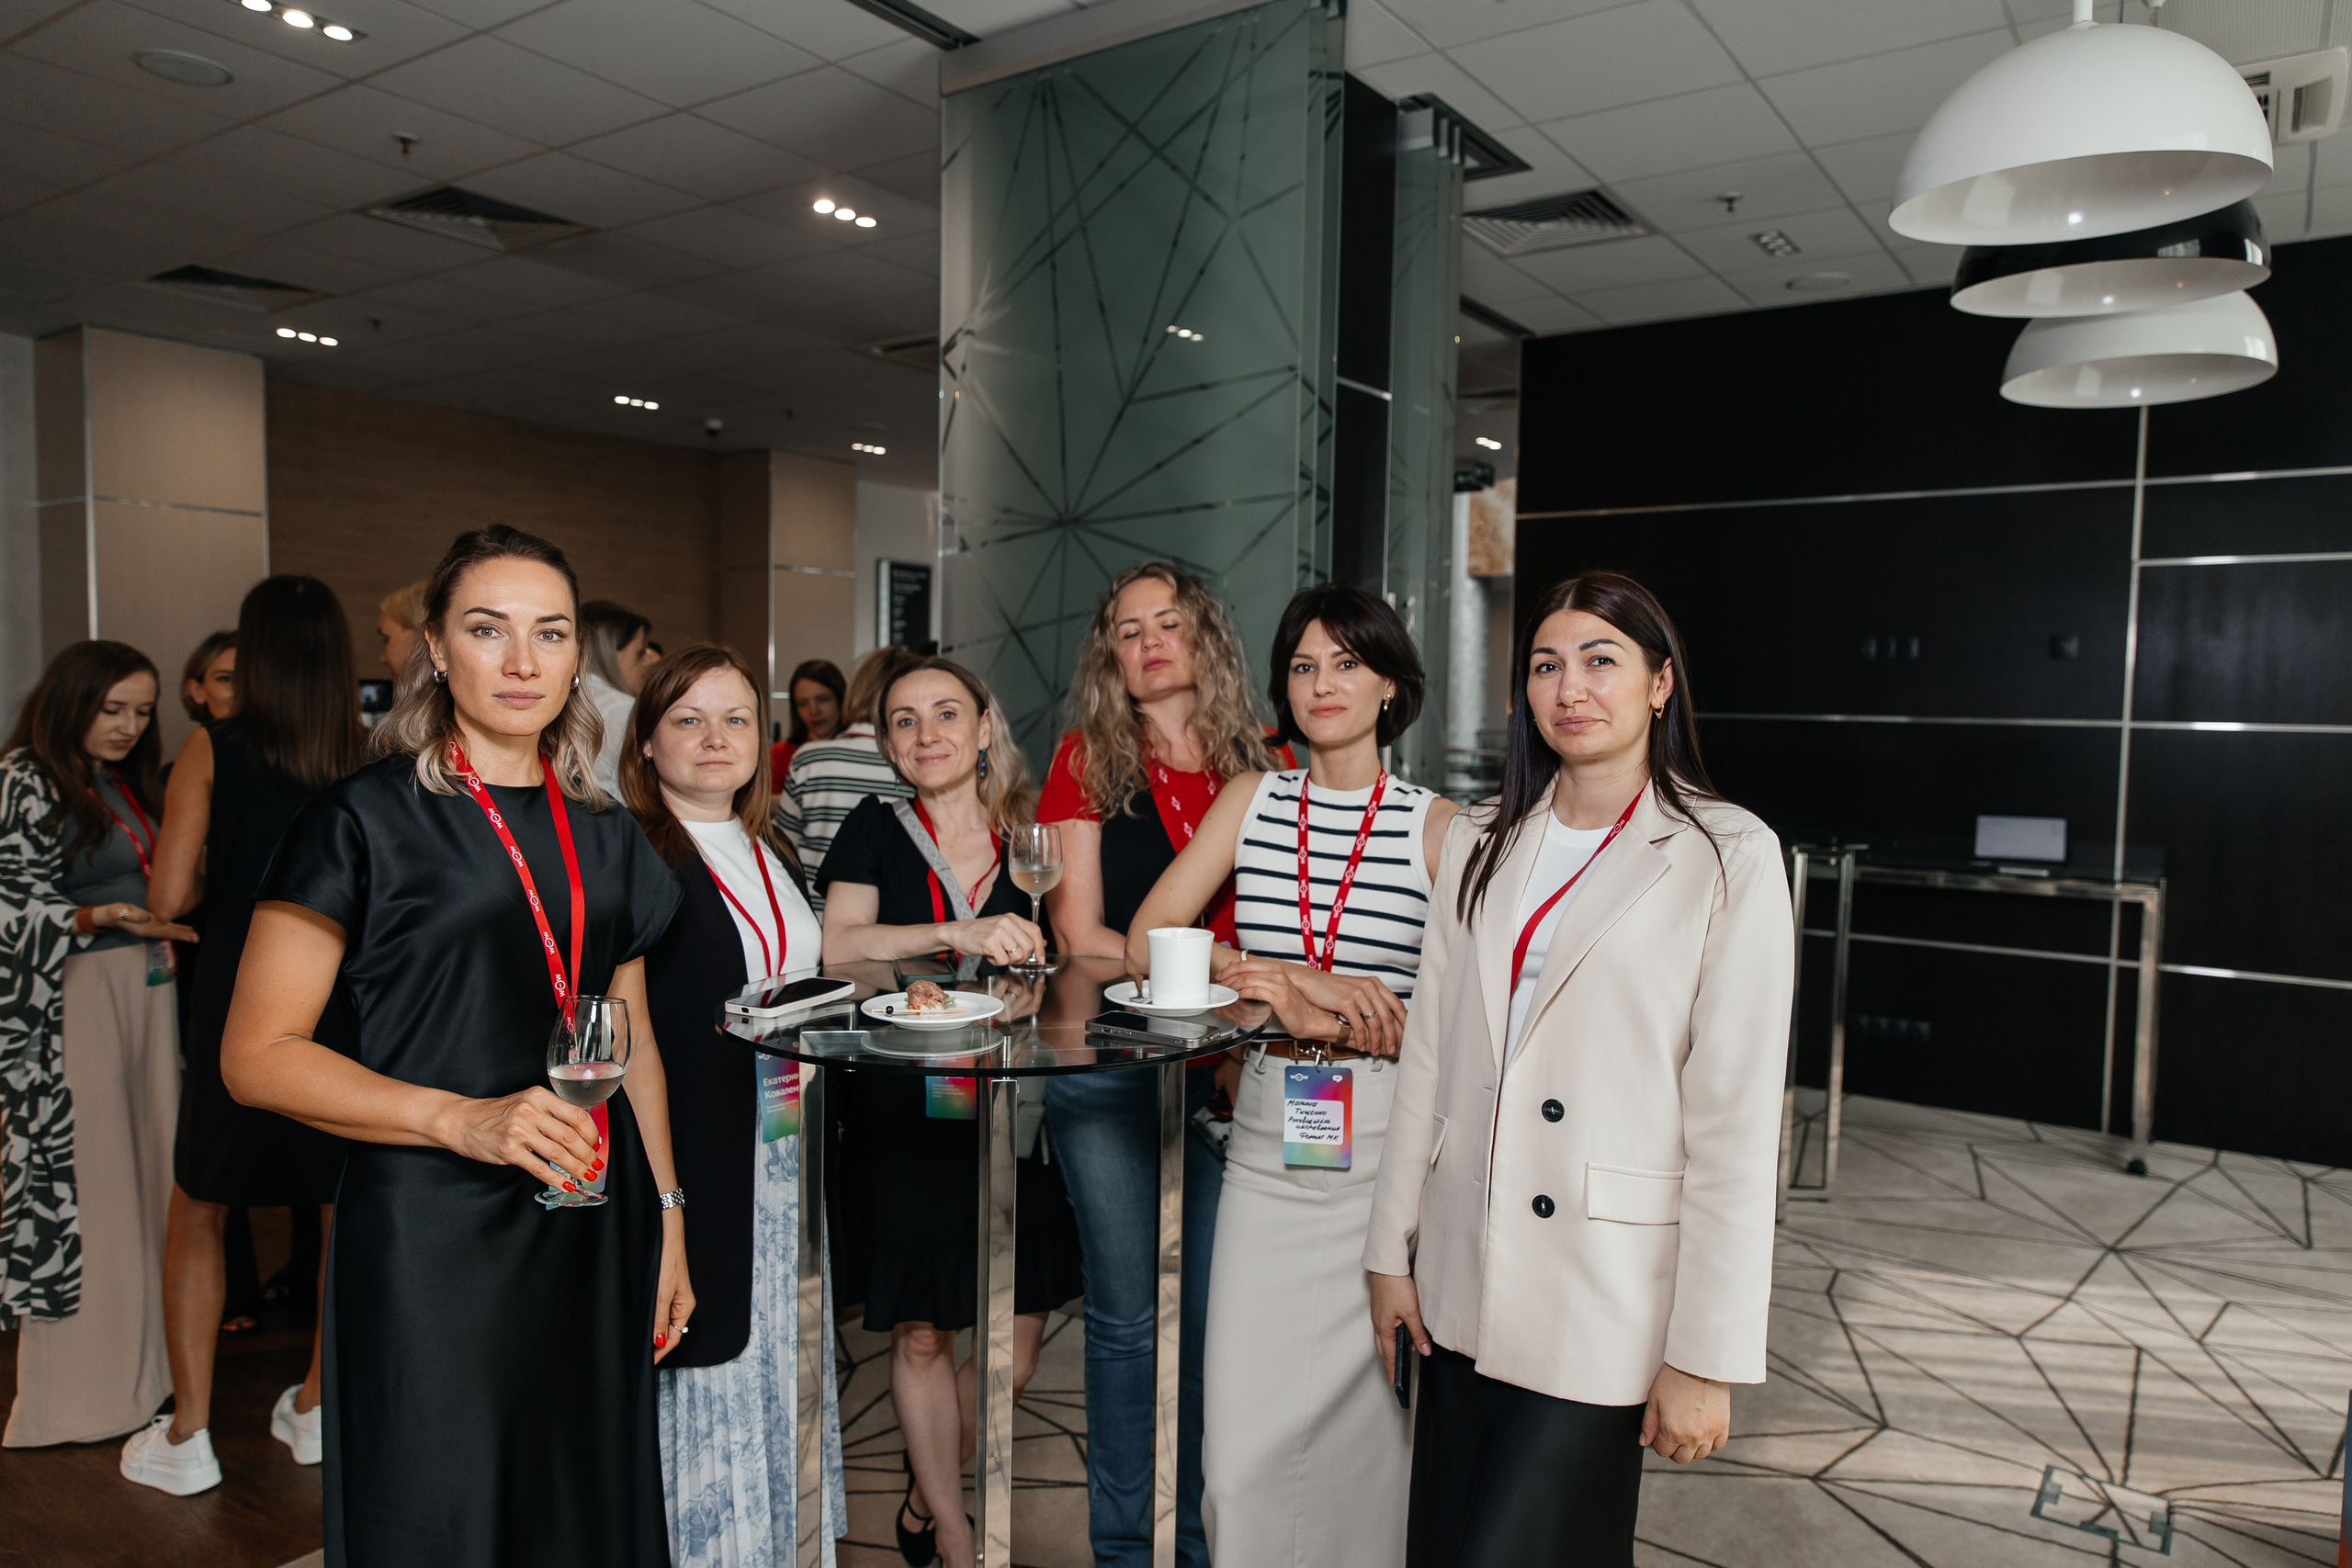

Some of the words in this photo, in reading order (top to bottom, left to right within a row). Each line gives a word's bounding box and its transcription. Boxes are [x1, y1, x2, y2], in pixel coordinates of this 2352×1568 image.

[488, 807, 503, 829] WOW
[1610, 819, 1625, 839] WOW
[510, 845, 524, 868] WOW
[527, 889, 539, 913] WOW
[543, 931, 555, 955] WOW
[1307, 953, 1317, 969] WO
[554, 974, 566, 998] WOW
[1290, 1073, 1308, 1081] WOW
